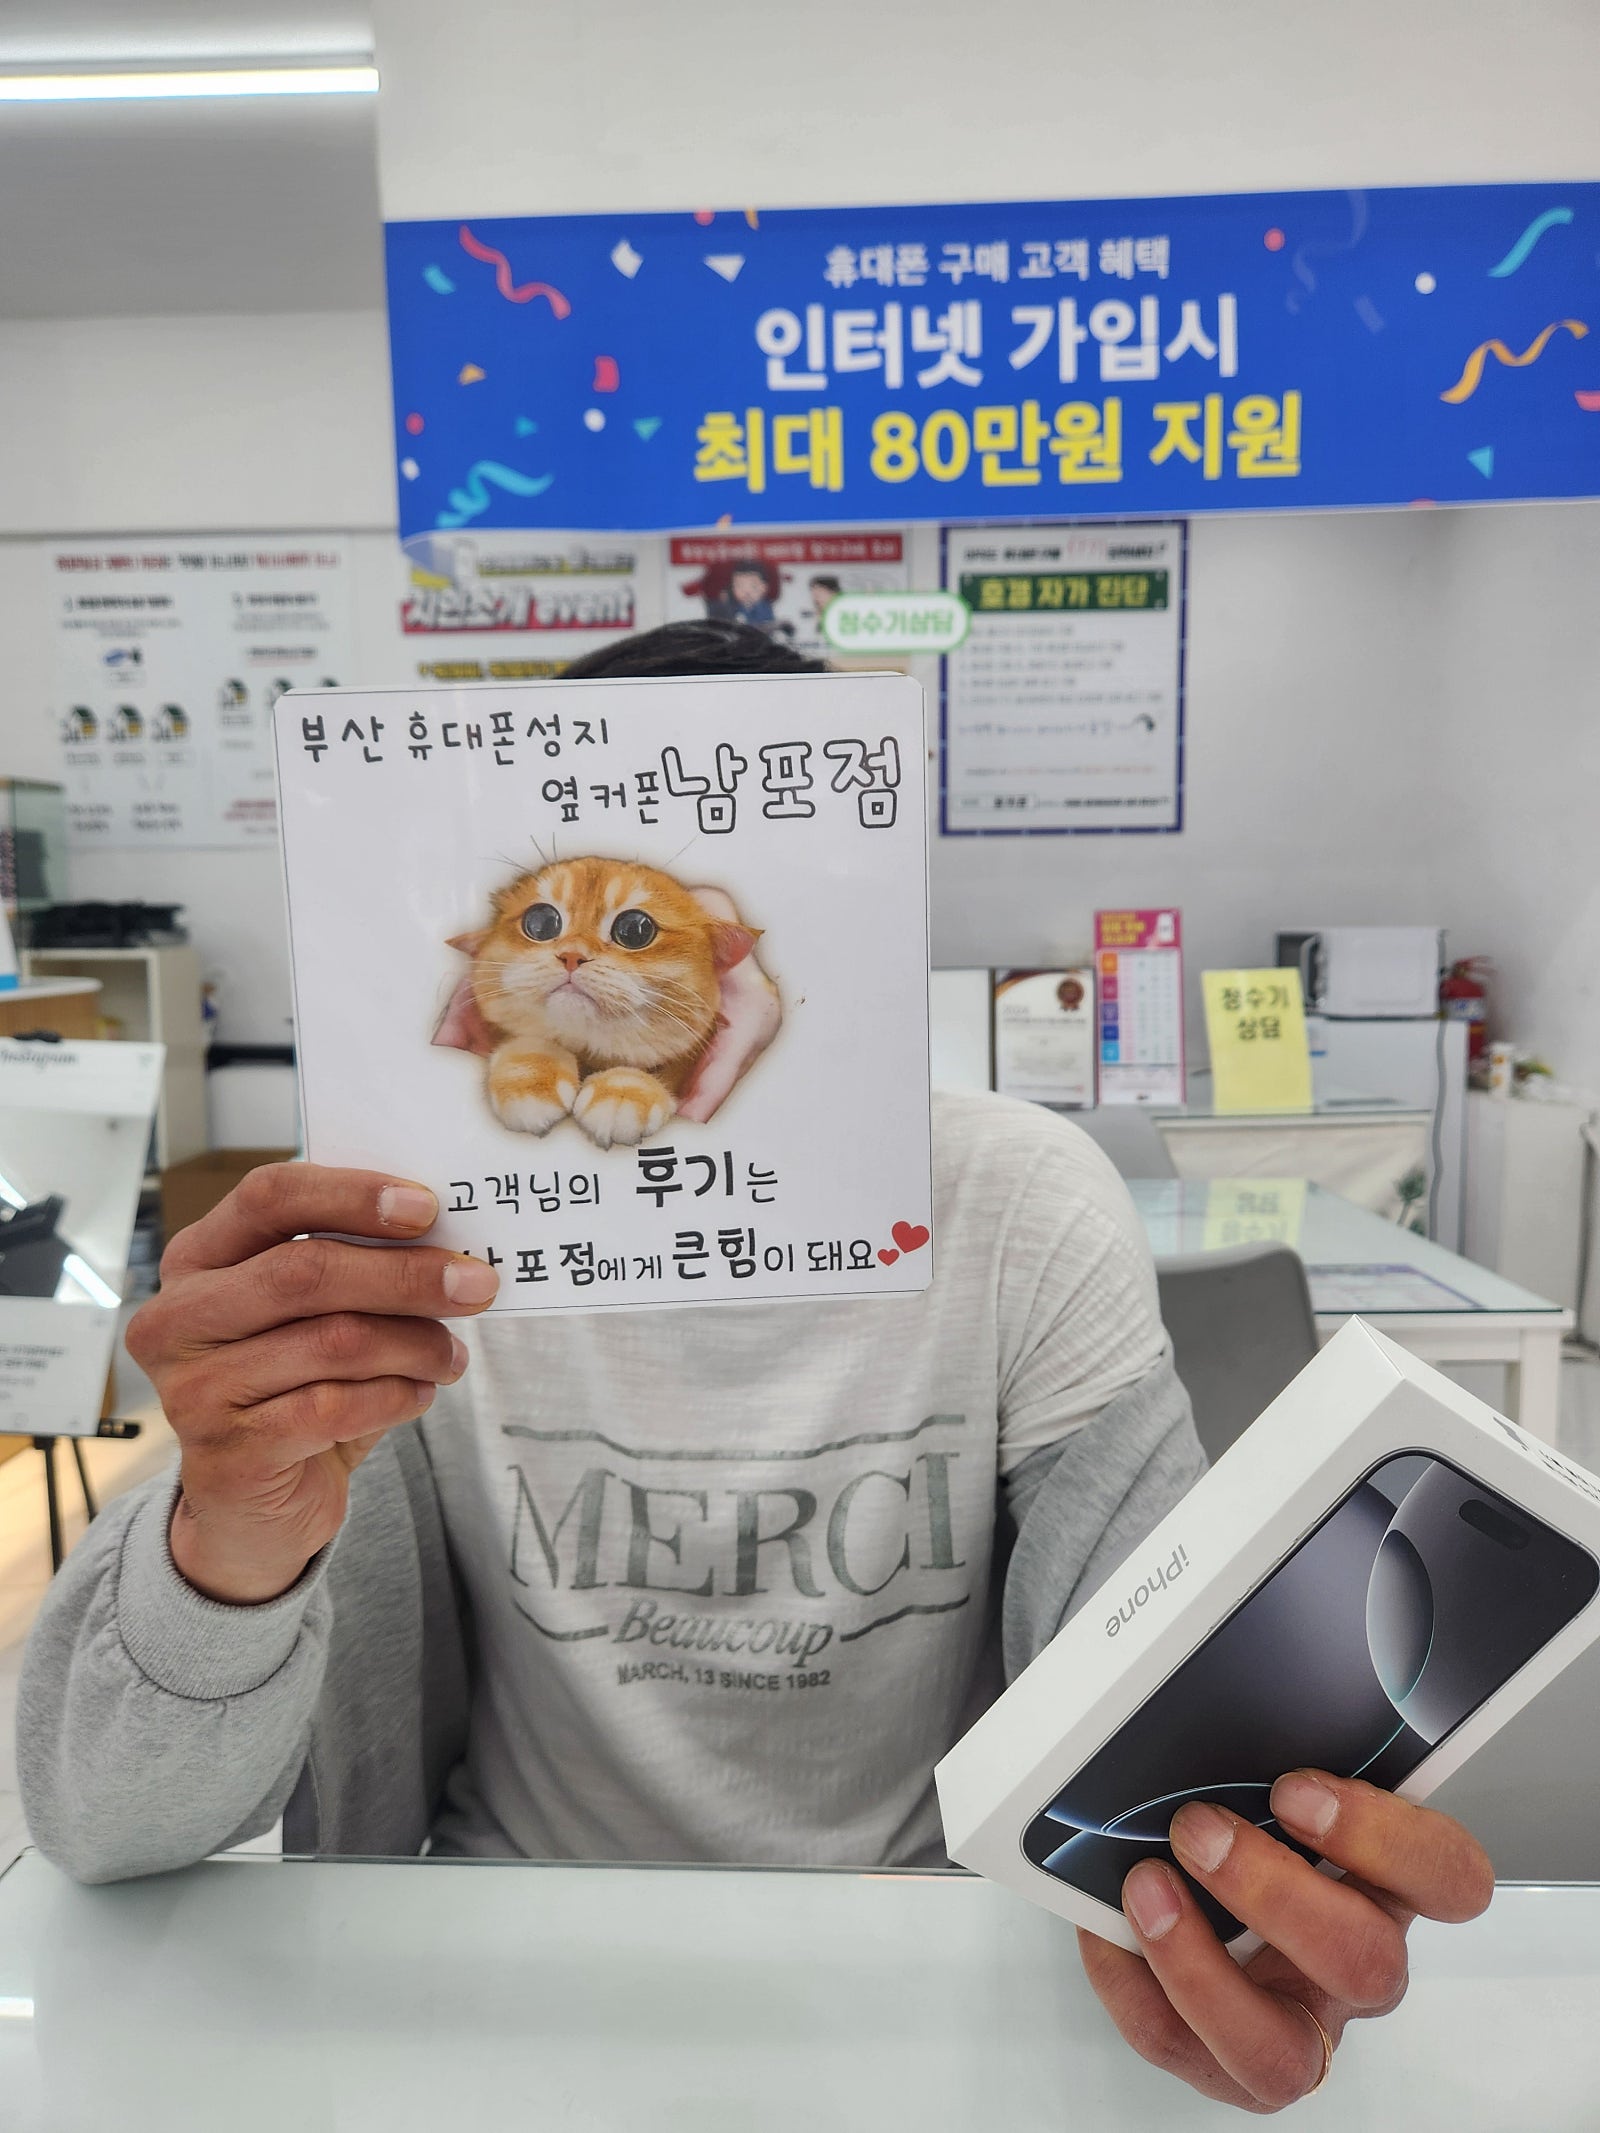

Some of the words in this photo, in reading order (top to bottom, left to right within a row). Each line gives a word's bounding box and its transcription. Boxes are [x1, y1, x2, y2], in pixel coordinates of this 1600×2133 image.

[823, 245, 928, 288] 휴대폰
[938, 241, 1010, 284] 구매
[1018, 239, 1090, 281] 고객
[1098, 236, 1170, 279] 혜택
[755, 300, 983, 392] 인터넷
[1008, 293, 1238, 384] 가입시
[692, 405, 845, 494] 최대
[869, 396, 1123, 488] 80만원
[1149, 390, 1301, 481] 지원
[302, 714, 385, 763] 부산
[661, 736, 901, 835] 남포점
[1221, 986, 1289, 1010] 정수기
[1237, 1016, 1280, 1039] 상담
[447, 1171, 600, 1214] 고객님의
[806, 1238, 876, 1273] 돼요
[507, 1452, 967, 1598] MERCI
[1105, 1543, 1190, 1638] iPhone
[612, 1600, 834, 1669] Beaucoup
[617, 1662, 689, 1685] MARCH,
[694, 1668, 715, 1685] 13
[719, 1671, 780, 1690] SINCE
[785, 1670, 831, 1689] 1982
